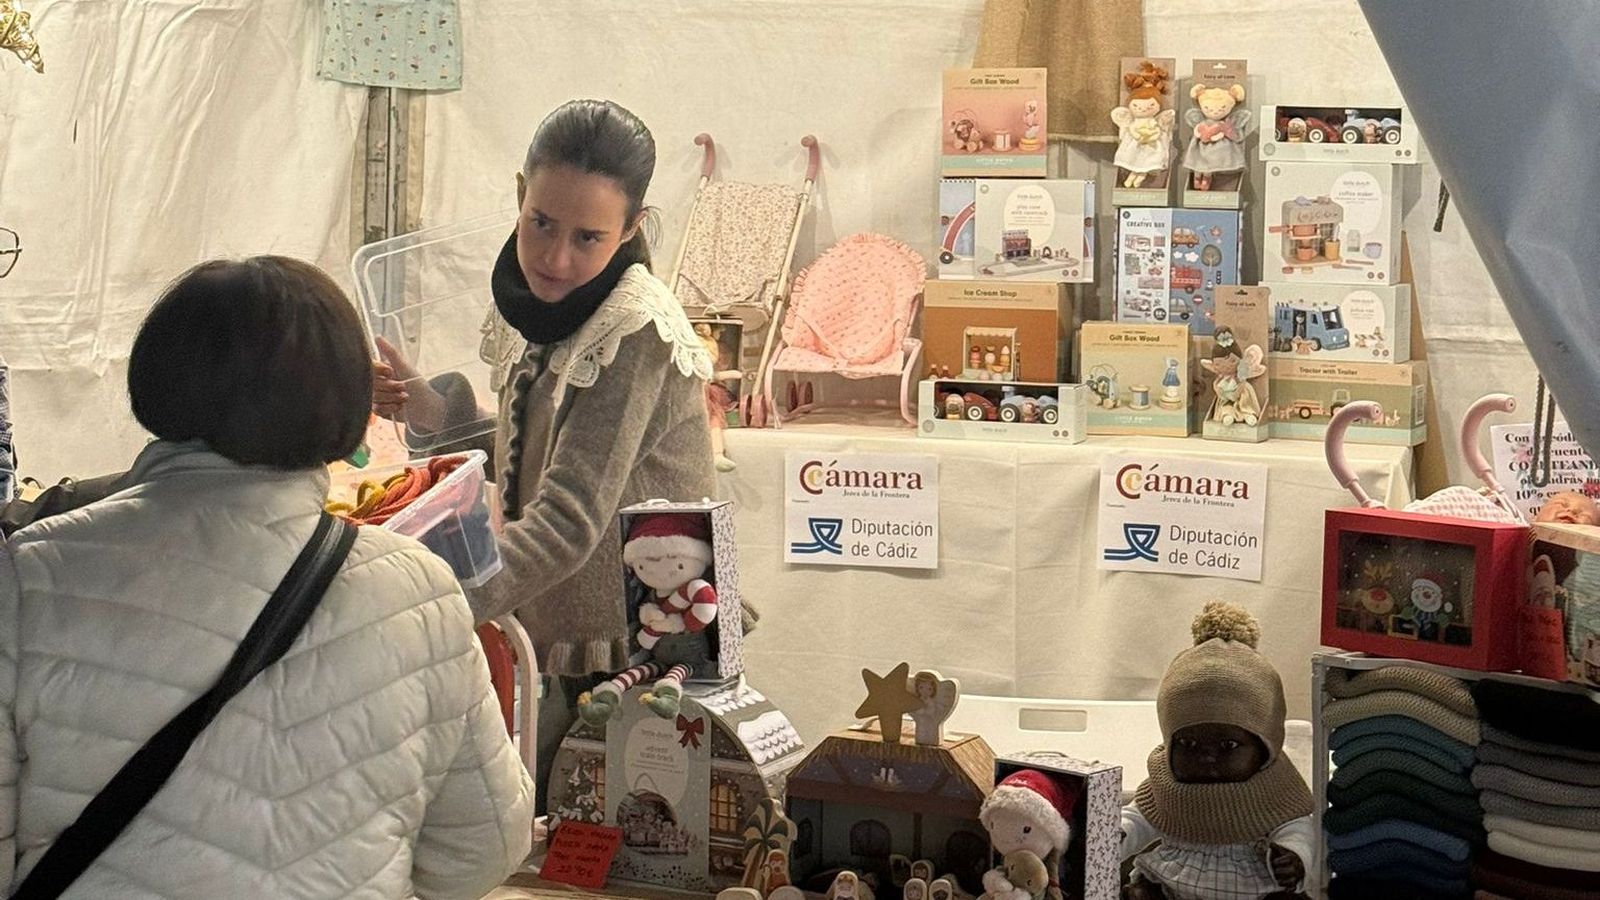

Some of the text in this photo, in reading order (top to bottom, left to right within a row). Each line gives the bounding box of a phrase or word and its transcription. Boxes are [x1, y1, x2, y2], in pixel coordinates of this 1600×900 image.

[976, 289, 999, 297] Cream
[1000, 290, 1017, 298] Shop
[1505, 433, 1530, 443] Con
[799, 459, 923, 495] Cámara
[1115, 463, 1250, 500] Cámara
[1182, 496, 1192, 504] de
[1516, 490, 1543, 500] 10%
[851, 518, 933, 537] Diputación
[1169, 524, 1258, 548] Diputación
[851, 541, 918, 559] de Cádiz
[1168, 548, 1241, 570] de Cádiz
